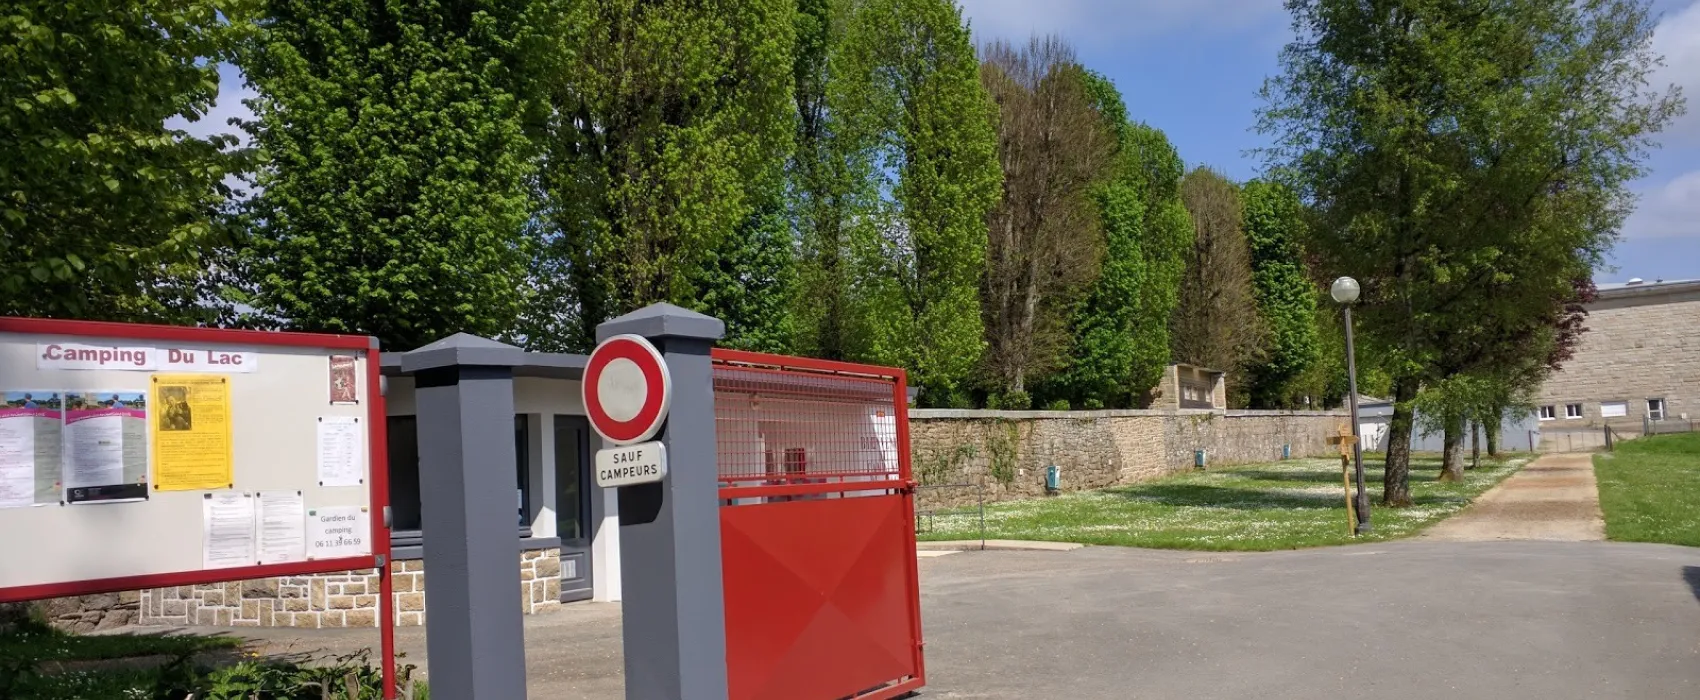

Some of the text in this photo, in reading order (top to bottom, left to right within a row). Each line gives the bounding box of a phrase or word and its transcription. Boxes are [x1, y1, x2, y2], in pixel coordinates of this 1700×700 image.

[46, 345, 243, 366] Camping Du Lac
[613, 450, 643, 464] SAUF
[600, 464, 658, 480] CAMPEURS
[320, 514, 346, 522] Gardien
[324, 527, 352, 535] camping
[315, 540, 324, 548] 06
